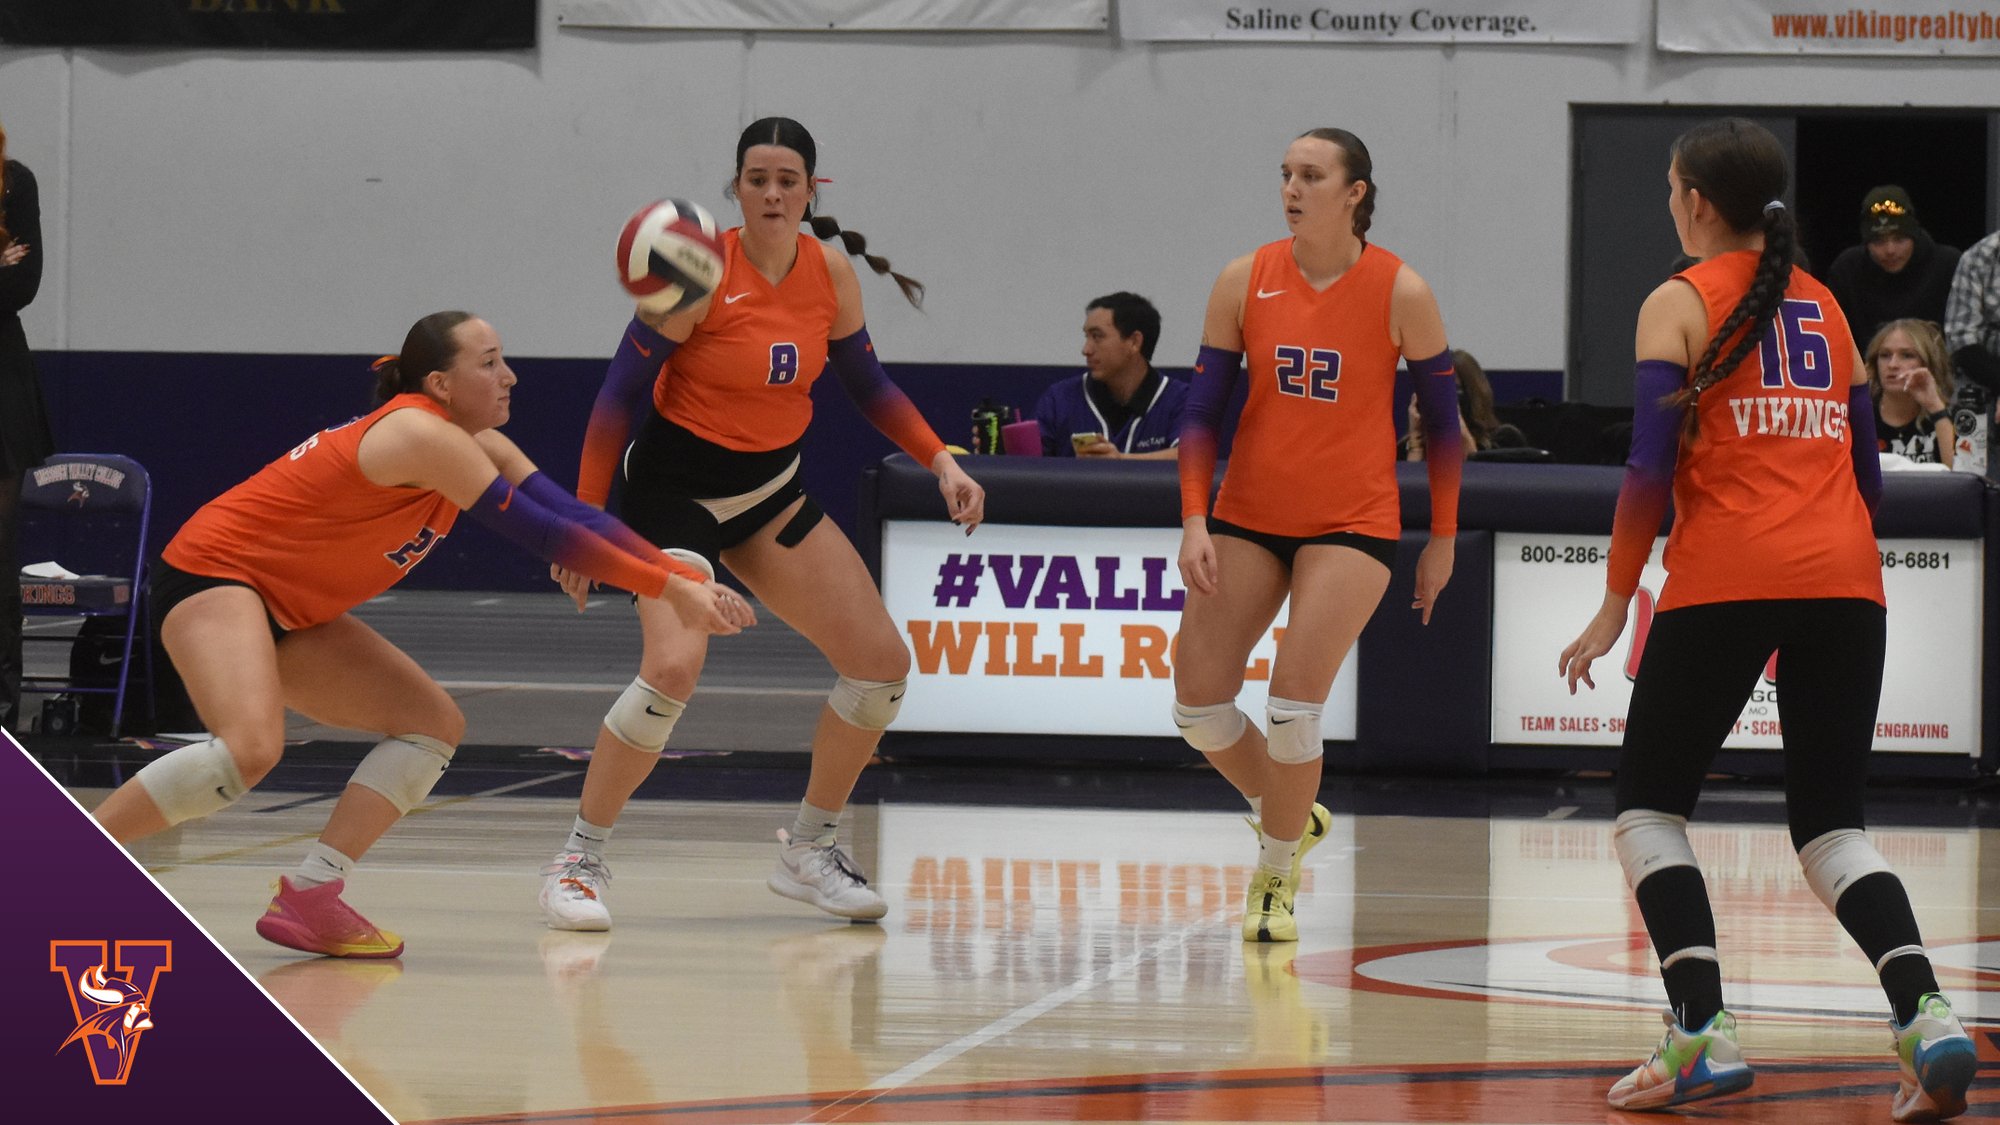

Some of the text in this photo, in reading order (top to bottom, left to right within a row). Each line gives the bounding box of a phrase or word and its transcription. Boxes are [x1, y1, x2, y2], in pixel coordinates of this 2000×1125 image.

[1226, 8, 1536, 36] Saline County Coverage.
[766, 342, 799, 386] 8
[1758, 298, 1832, 391] 16
[1275, 344, 1342, 403] 22
[1729, 396, 1847, 443] VIKINGS
[933, 553, 1187, 612] #VALL
[907, 620, 1104, 678] WILL
[1521, 716, 1555, 731] TEAM
[1559, 717, 1599, 732] SALES
[1876, 722, 1949, 739] ENGRAVING
